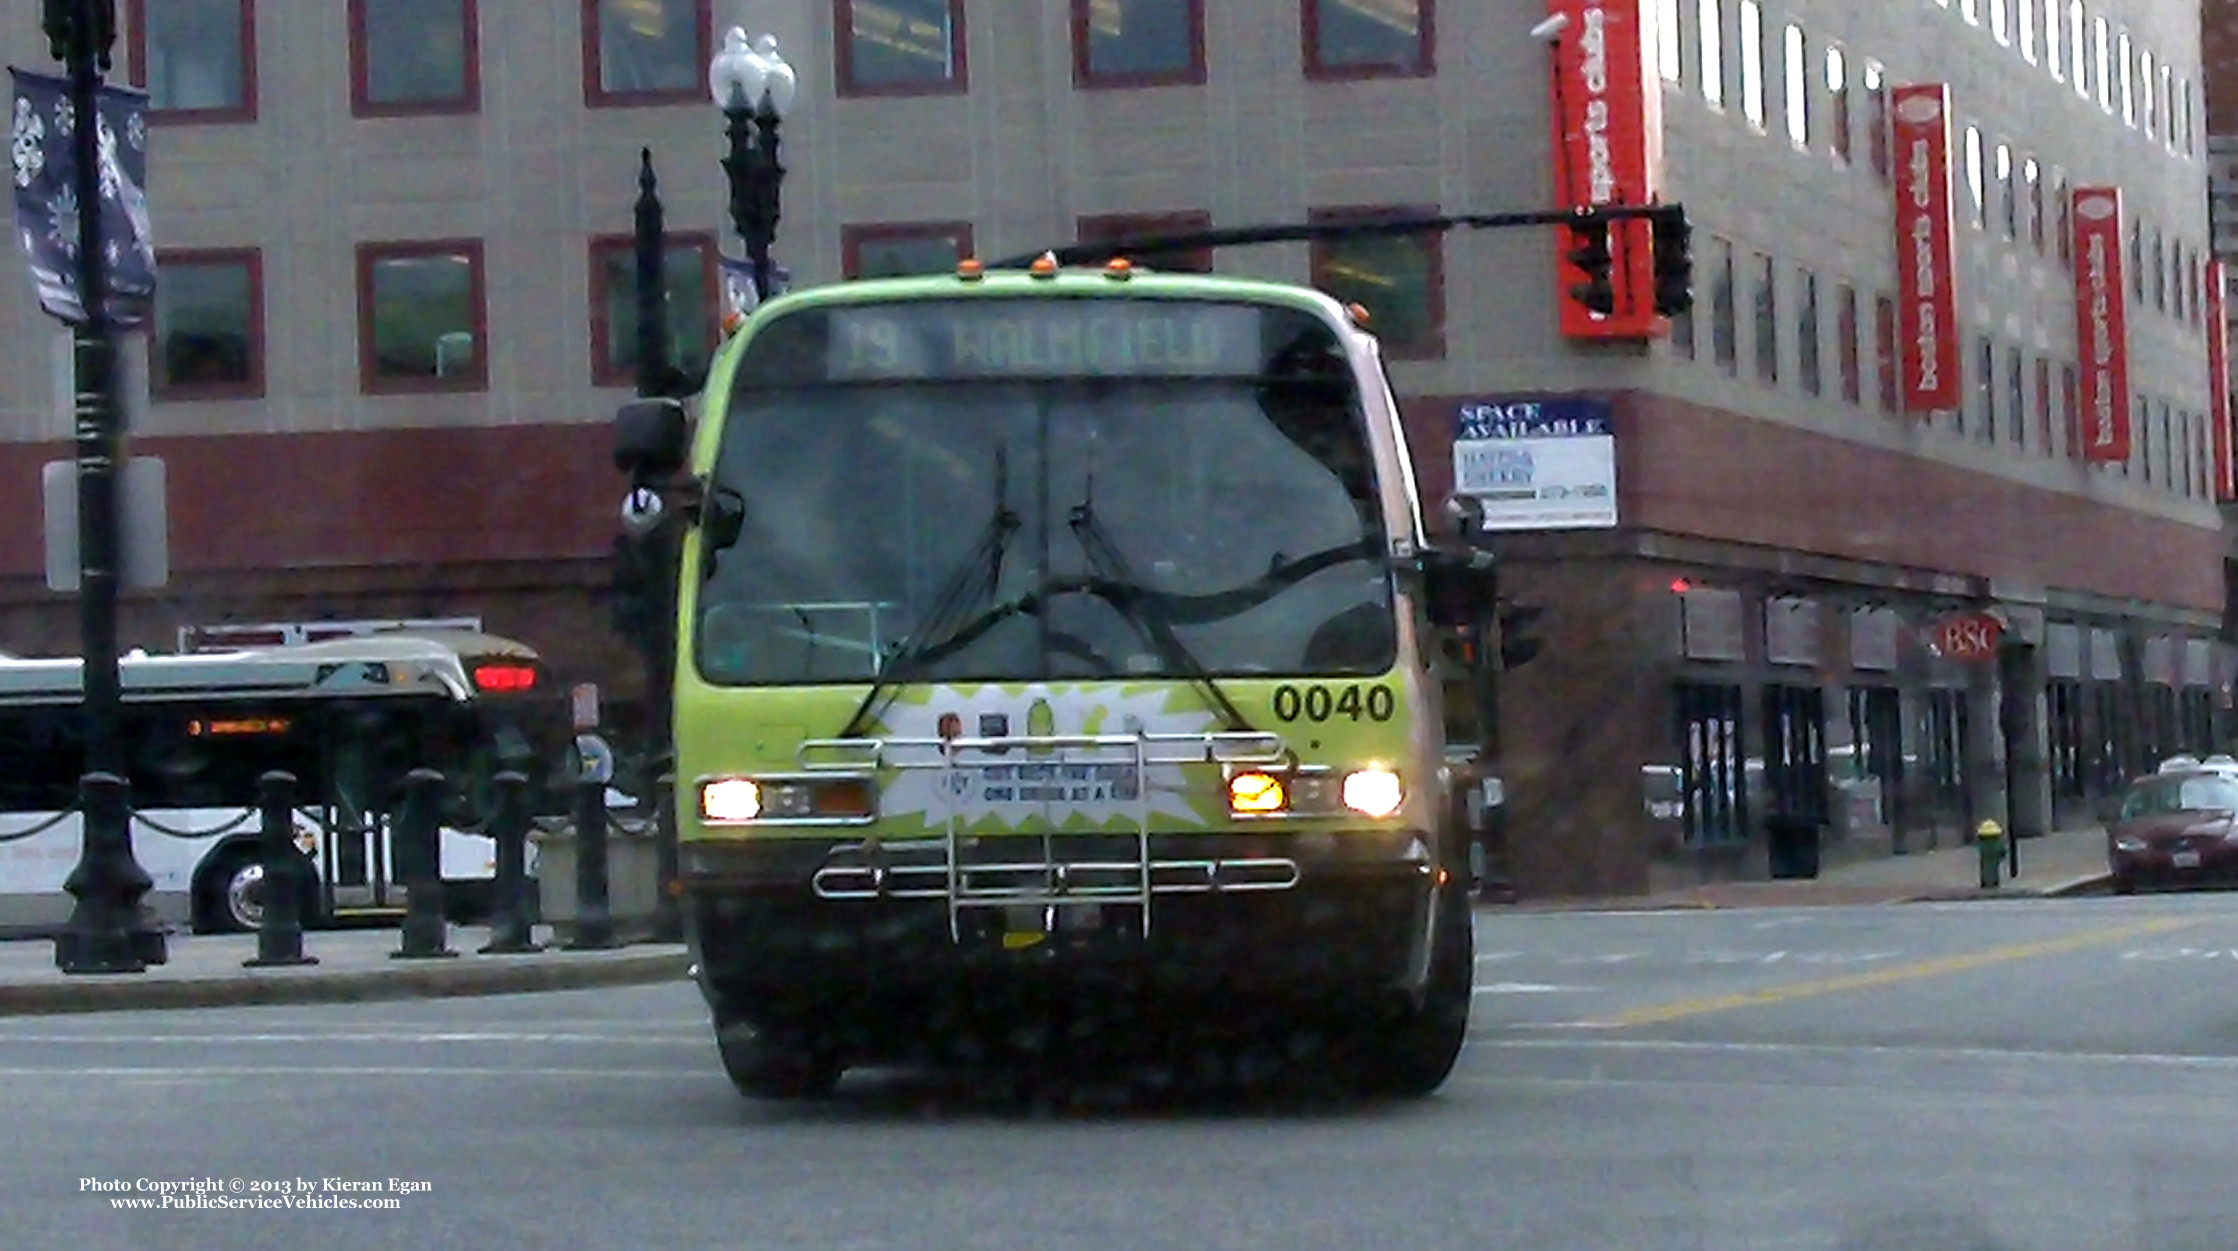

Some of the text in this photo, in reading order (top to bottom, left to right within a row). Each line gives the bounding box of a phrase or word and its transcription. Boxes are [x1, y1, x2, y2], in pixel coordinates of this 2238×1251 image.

[1579, 8, 1607, 93] clubs
[1586, 100, 1616, 204] sports
[1907, 138, 1930, 208] clubs
[1910, 214, 1936, 298] sports
[850, 318, 899, 367] 19
[1915, 302, 1938, 391] boston
[1461, 403, 1541, 420] SPACE
[1461, 419, 1602, 438] AVAILABLE
[1274, 684, 1394, 722] 0040
